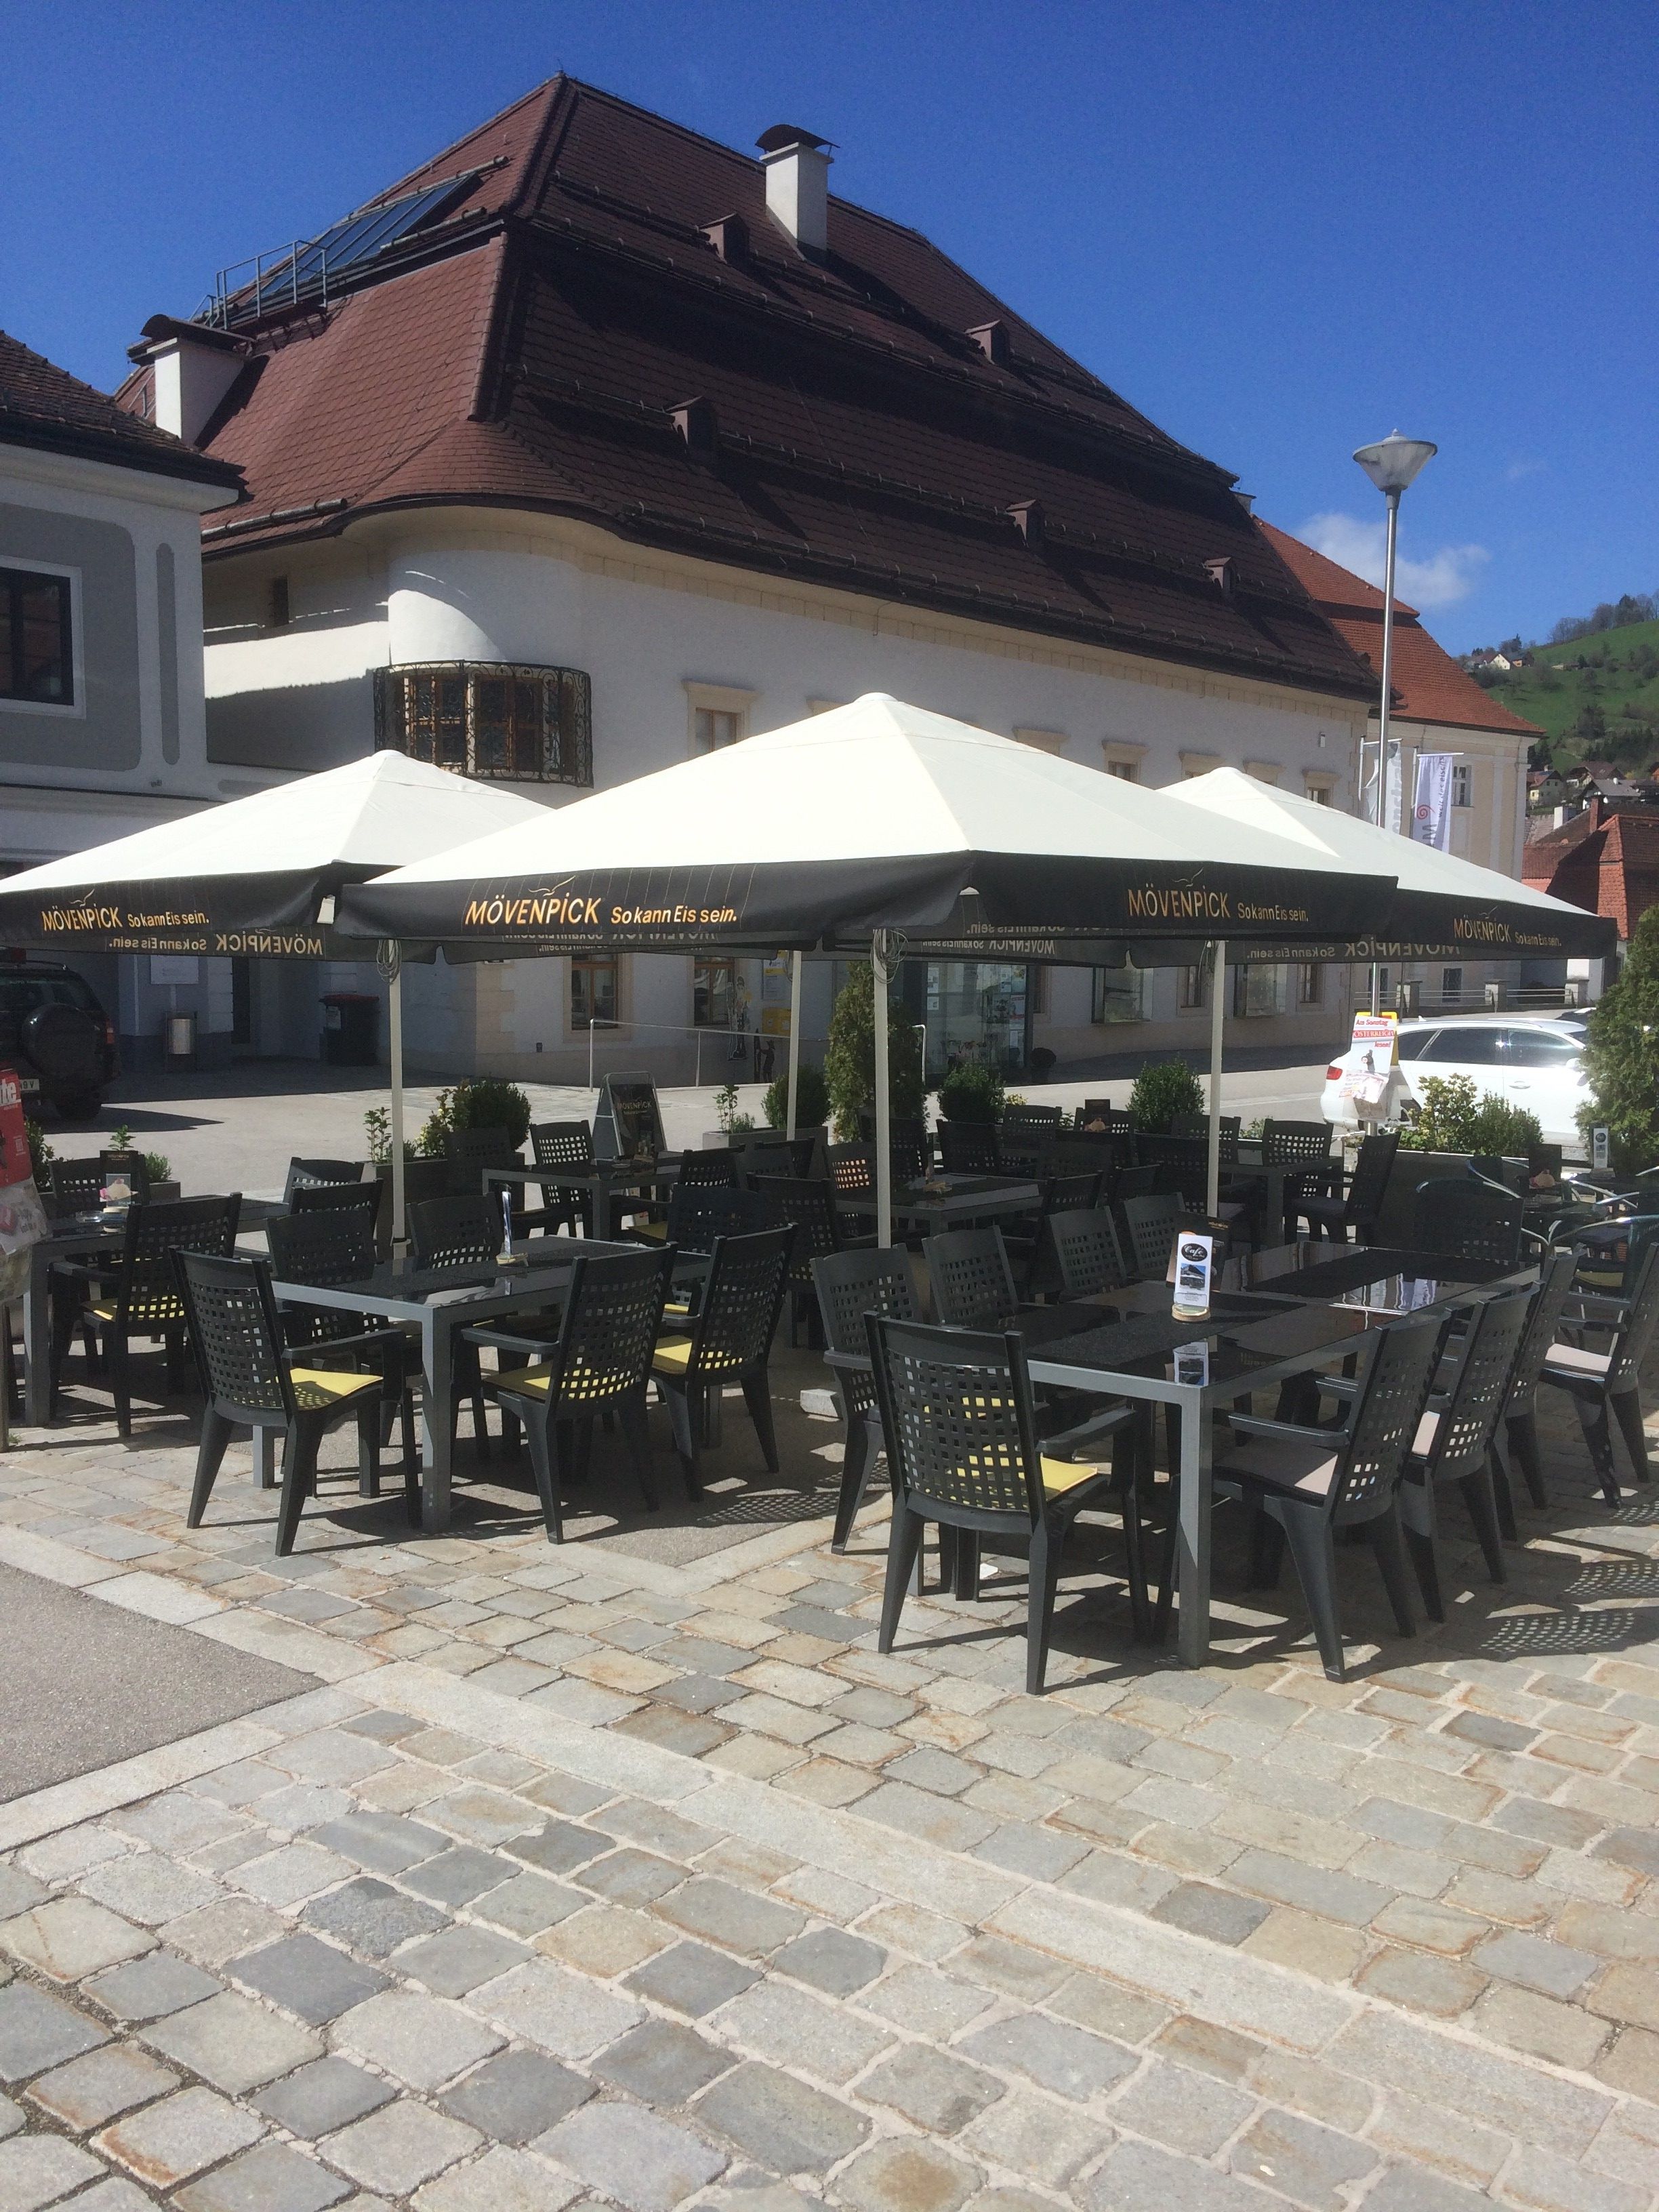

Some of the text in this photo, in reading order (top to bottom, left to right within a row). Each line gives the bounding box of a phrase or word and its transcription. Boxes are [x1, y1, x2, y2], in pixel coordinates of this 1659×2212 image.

[465, 893, 602, 924] MÖVENPICK
[1128, 883, 1231, 918] MÖVENPICK
[41, 903, 123, 931] MÖVENPICK
[1454, 914, 1512, 943] MÖVENPICK
